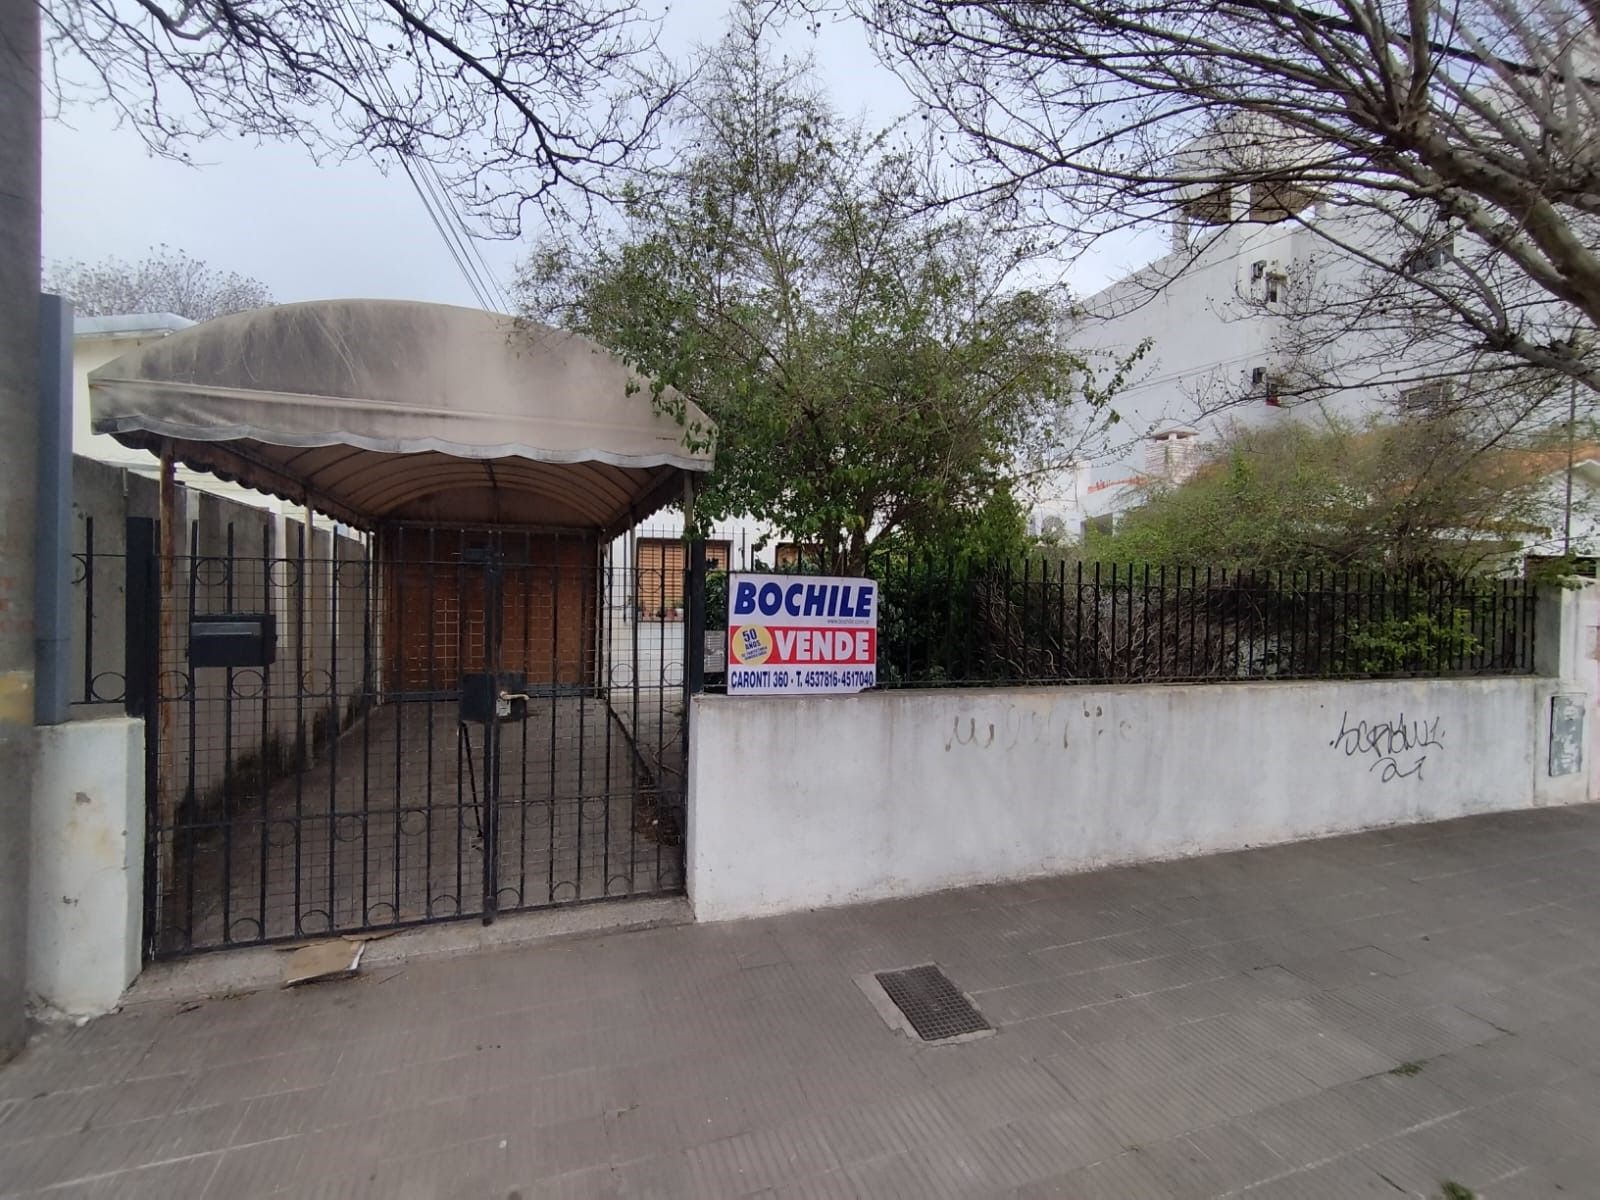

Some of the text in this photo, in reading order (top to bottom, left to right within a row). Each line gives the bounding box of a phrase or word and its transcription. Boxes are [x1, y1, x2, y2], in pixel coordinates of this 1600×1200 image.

[734, 582, 874, 617] BOCHILE
[742, 628, 757, 642] 50
[774, 630, 869, 661] VENDE
[731, 671, 771, 688] CARONTI
[773, 671, 789, 688] 360
[796, 671, 803, 688] T.
[805, 671, 874, 687] 4537816-4517040
